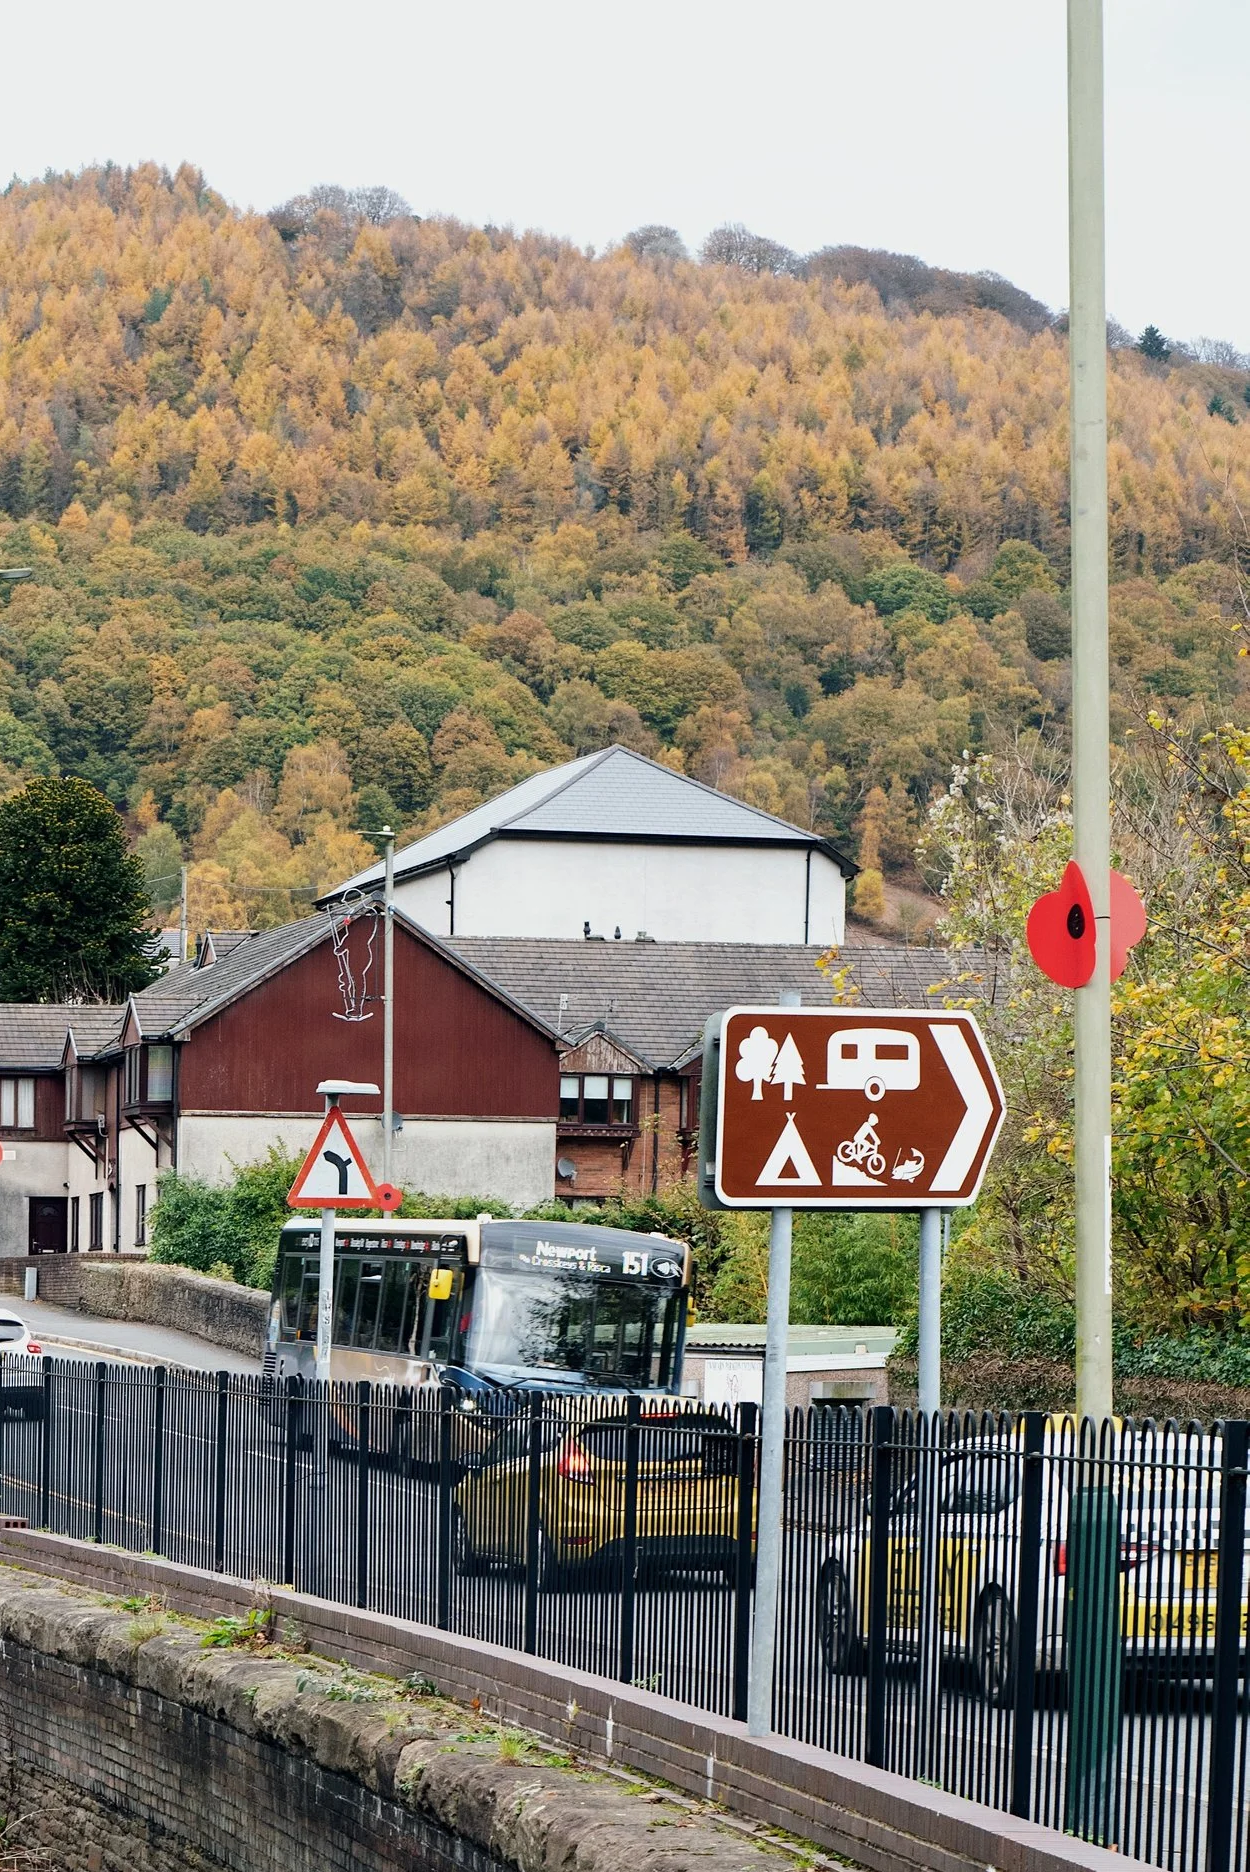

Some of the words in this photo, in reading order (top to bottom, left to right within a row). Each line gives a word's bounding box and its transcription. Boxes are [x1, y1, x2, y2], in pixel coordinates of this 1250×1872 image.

[536, 1241, 597, 1262] Newport
[578, 1261, 587, 1271] &
[587, 1261, 611, 1274] Risca
[622, 1251, 649, 1276] 151
[1150, 1613, 1216, 1631] 0495
